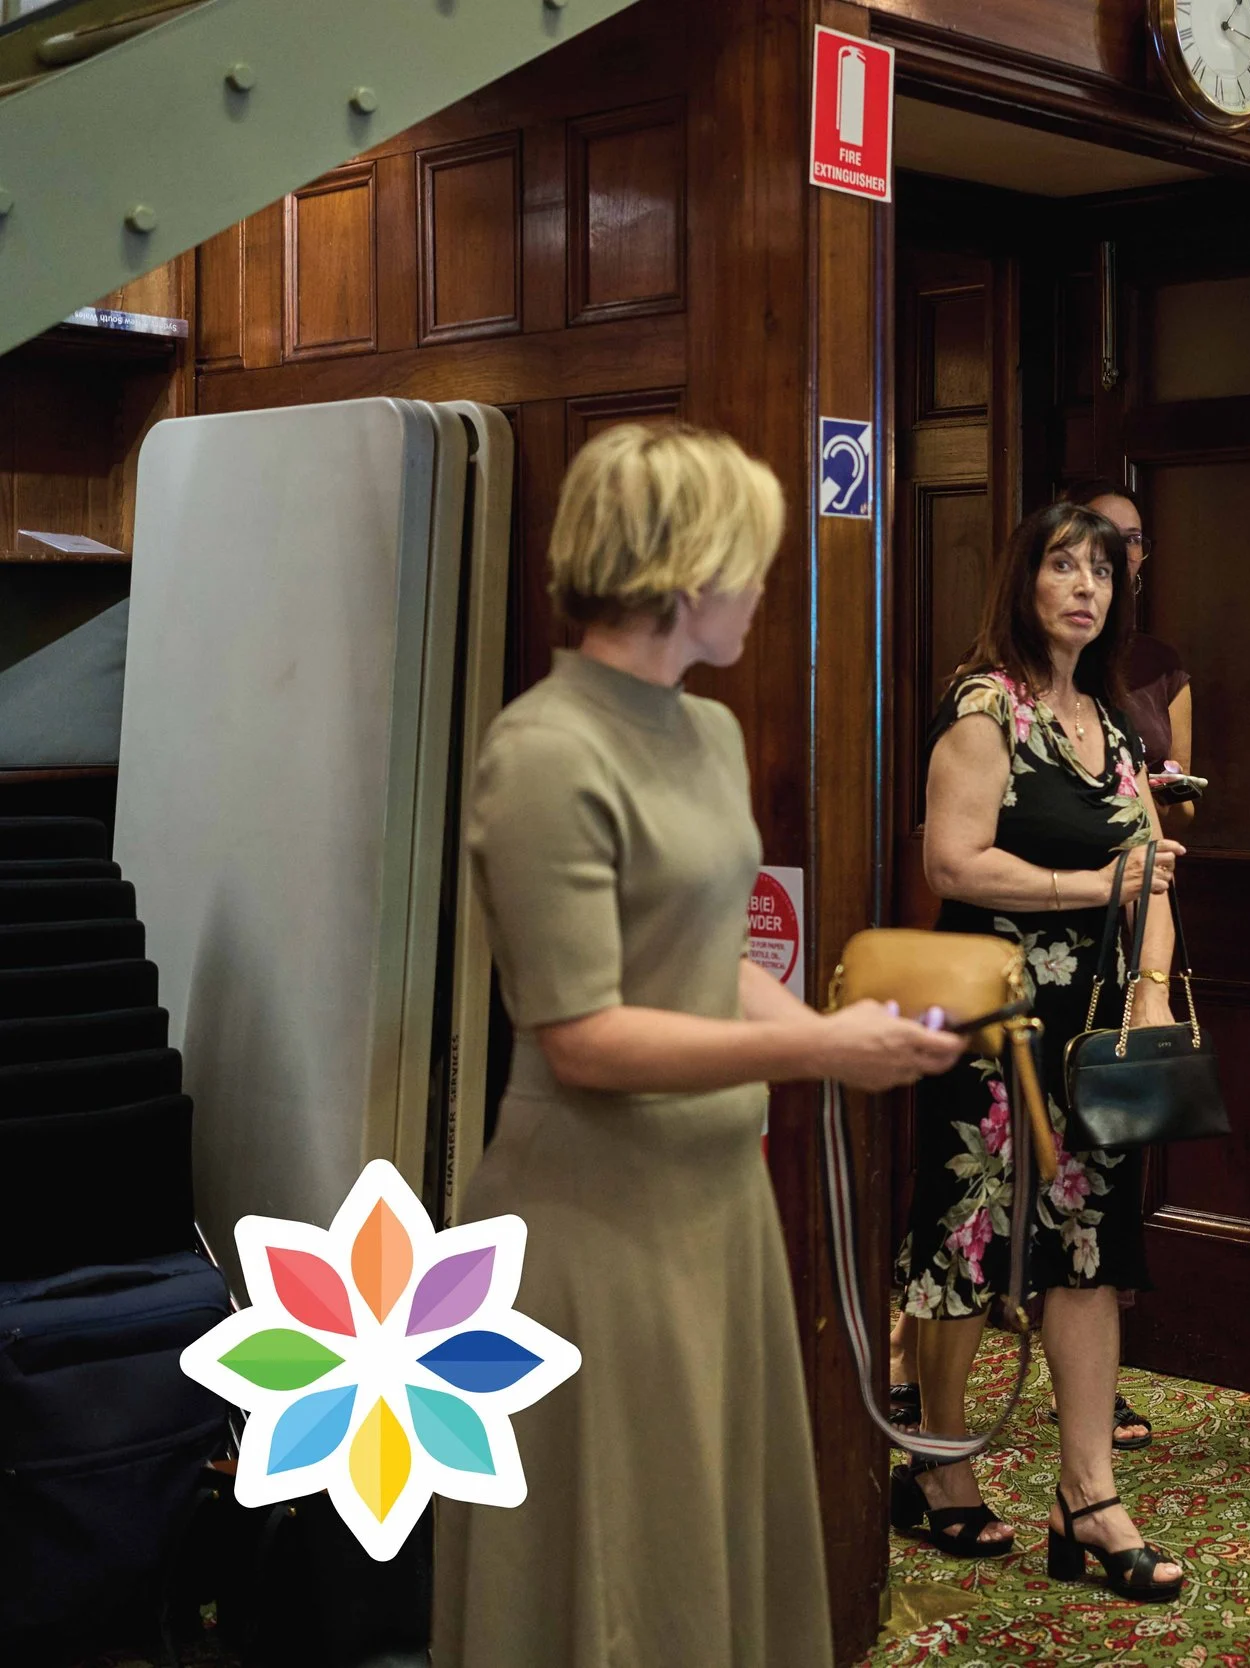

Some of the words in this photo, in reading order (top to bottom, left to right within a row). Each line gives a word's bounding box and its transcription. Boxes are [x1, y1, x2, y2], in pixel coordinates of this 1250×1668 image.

[839, 147, 862, 166] FIRE
[814, 161, 885, 192] EXTINGUISHER
[74, 311, 98, 322] Wales
[100, 313, 123, 325] South
[747, 896, 775, 914] B(E)
[748, 914, 783, 932] WDER
[450, 1035, 459, 1103] SERVICES
[446, 1111, 456, 1197] CHAMBER
